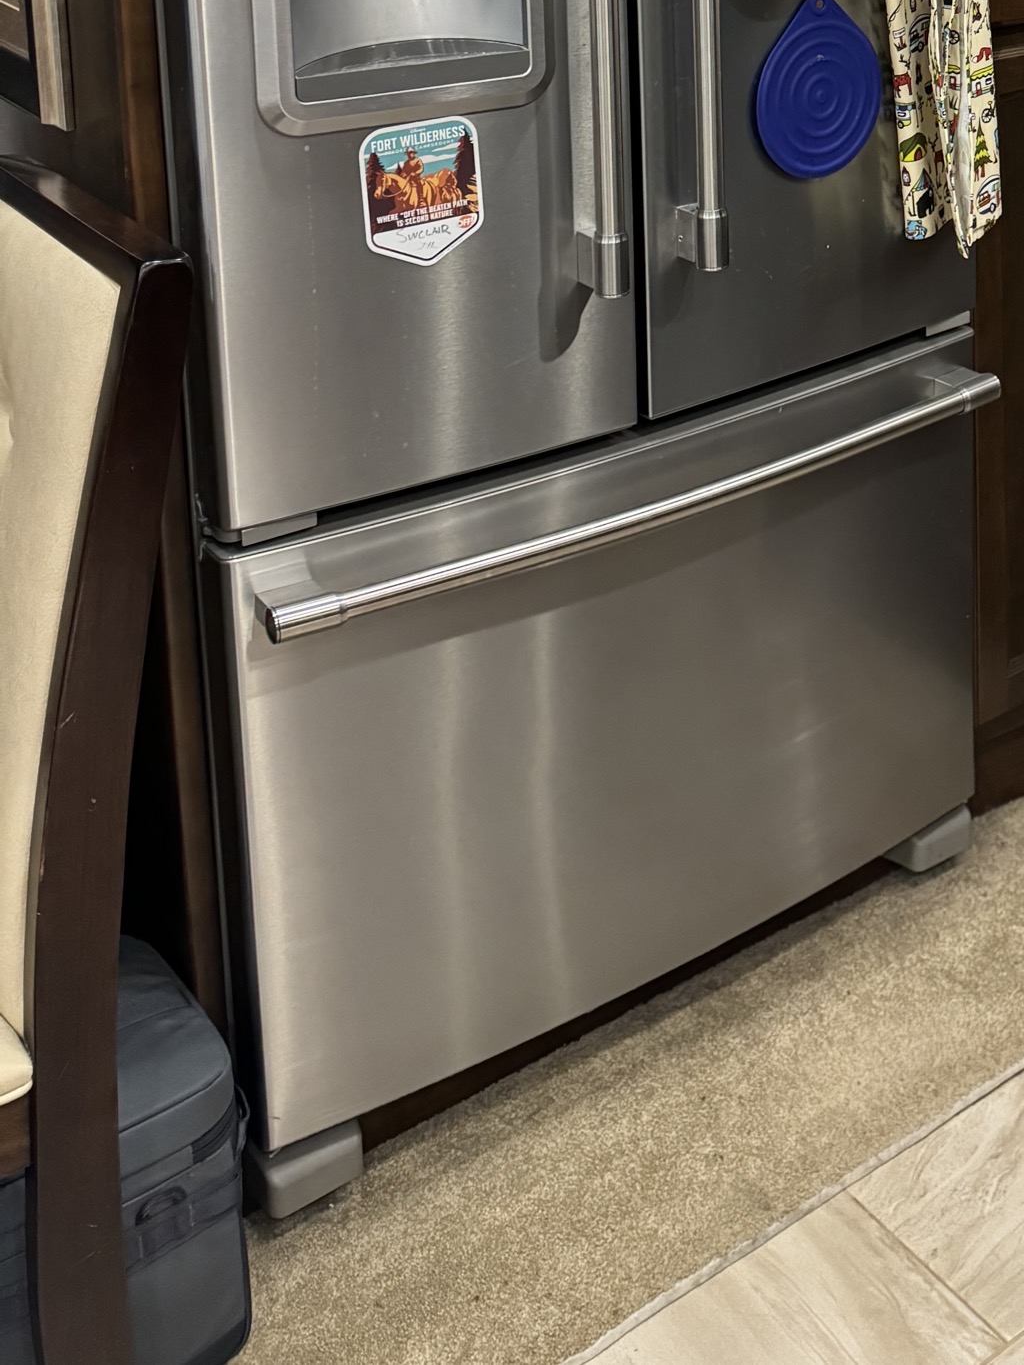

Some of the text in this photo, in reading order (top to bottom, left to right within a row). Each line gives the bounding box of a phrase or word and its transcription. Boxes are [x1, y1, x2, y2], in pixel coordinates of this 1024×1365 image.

[370, 125, 466, 153] FORT WILDERNESS
[376, 212, 399, 224] WHERE
[417, 207, 428, 215] THE
[428, 203, 451, 213] BEATEN
[405, 215, 429, 226] SECOND
[430, 209, 453, 220] NATURE
